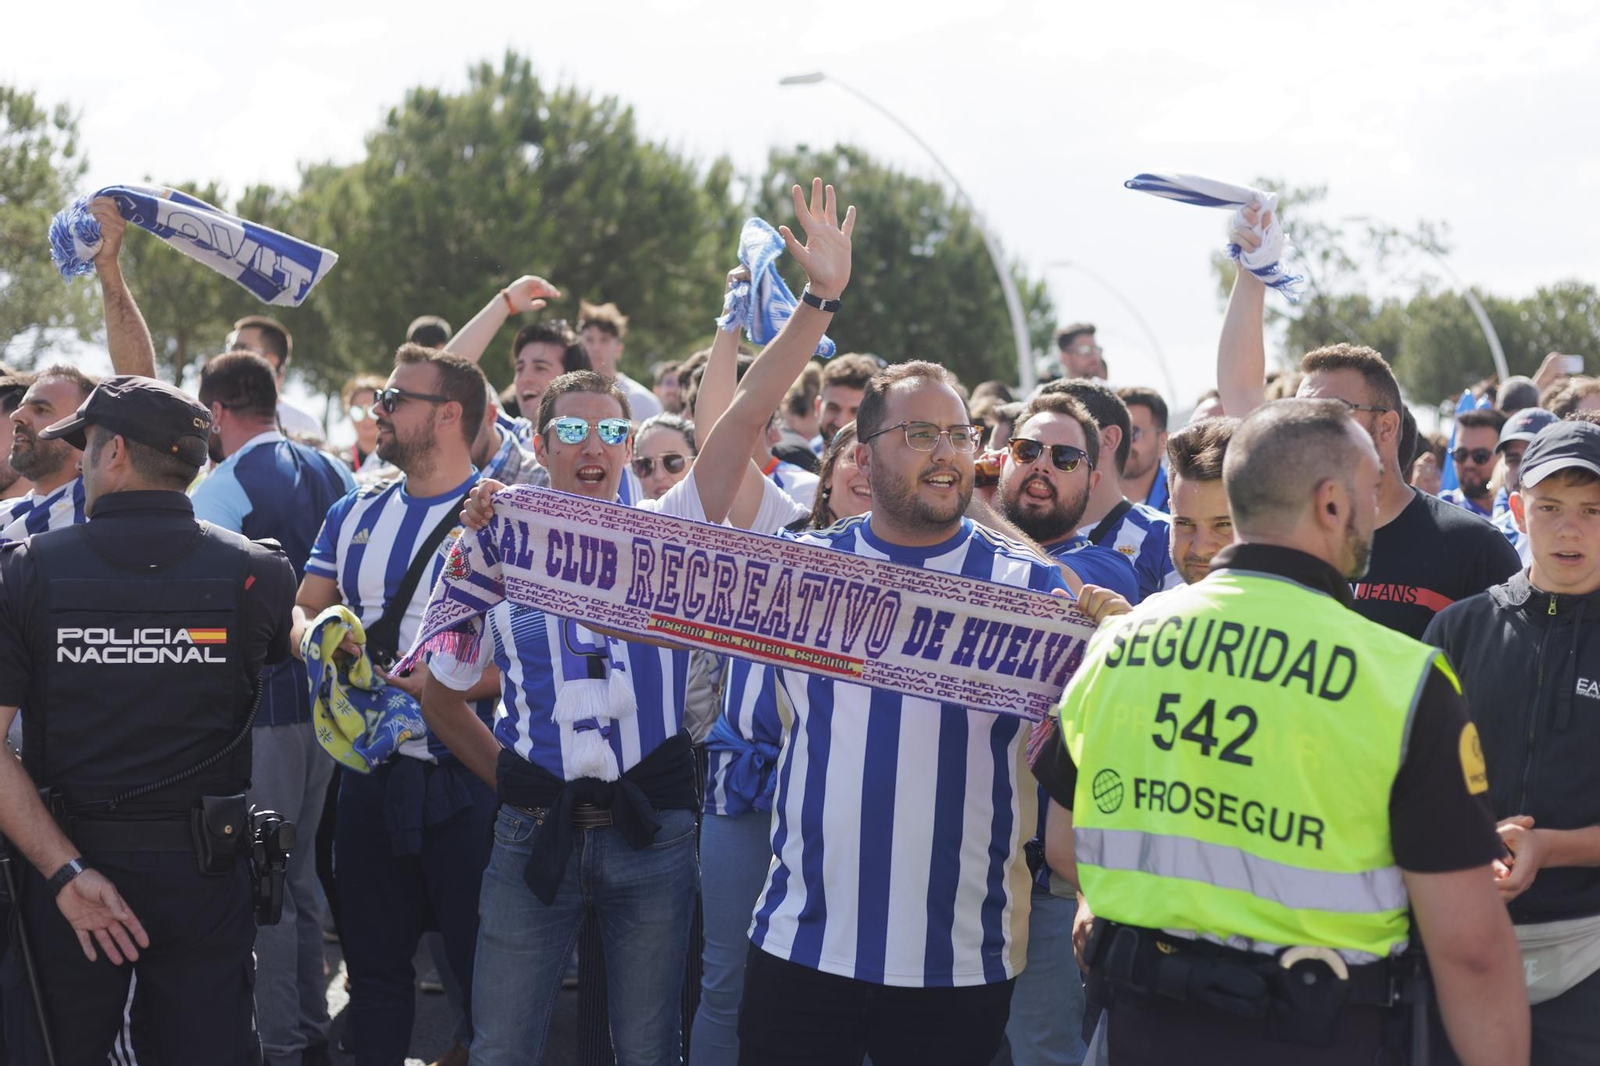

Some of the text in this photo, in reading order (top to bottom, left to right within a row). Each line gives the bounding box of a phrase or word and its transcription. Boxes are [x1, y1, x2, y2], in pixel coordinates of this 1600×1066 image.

[510, 501, 598, 526] RECREATIVO
[601, 522, 620, 531] DE
[623, 526, 680, 543] HUELVA
[686, 539, 778, 564] RECREATIVO
[782, 559, 802, 569] DE
[804, 563, 865, 582] HUELVA
[871, 578, 967, 603] RECREATIVO
[969, 598, 990, 608] DE
[993, 603, 1053, 620] HUELVA
[515, 495, 534, 505] DE
[536, 500, 592, 517] HUELVA
[599, 514, 688, 538] RECREATIVO
[691, 533, 712, 543] DE
[715, 538, 773, 556] HUELVA
[780, 551, 875, 576] RECREATIVO
[878, 571, 899, 581] DE
[901, 576, 961, 594] HUELVA
[968, 590, 1066, 616] RECREATIVO
[516, 488, 602, 512] RECREATIVO
[604, 506, 624, 516] DE
[626, 511, 682, 529] HUELVA
[689, 526, 782, 550] RECREATIVO
[785, 544, 806, 554] DE
[809, 550, 869, 568] HUELVA
[876, 564, 972, 589] RECREATIVO
[974, 584, 996, 593] DE
[998, 589, 1061, 607] HUELVA
[505, 575, 588, 602] RECREATIVO
[591, 598, 609, 608] DE
[506, 590, 585, 616] RECREATIVO
[587, 612, 605, 622] DE
[507, 585, 524, 595] DE
[526, 589, 579, 607] HUELVA
[1358, 583, 1418, 604] JEANS
[545, 528, 618, 591] CLUB
[625, 536, 902, 659] RECREATIVO
[901, 605, 955, 661] DE
[950, 616, 1087, 688] HUELVA
[655, 619, 706, 638] DECANO
[712, 633, 736, 645] DEL
[57, 646, 226, 663] NACIONAL
[1105, 616, 1358, 701] SEGURIDAD
[871, 667, 928, 685] HUELVA
[935, 681, 1027, 704] RECREATIVO
[937, 689, 956, 698] DE
[959, 693, 1017, 709] HUELVA
[940, 674, 959, 684] DE
[962, 679, 1019, 696] HUELVA
[1576, 678, 1600, 696] EA
[1152, 693, 1258, 767] 542
